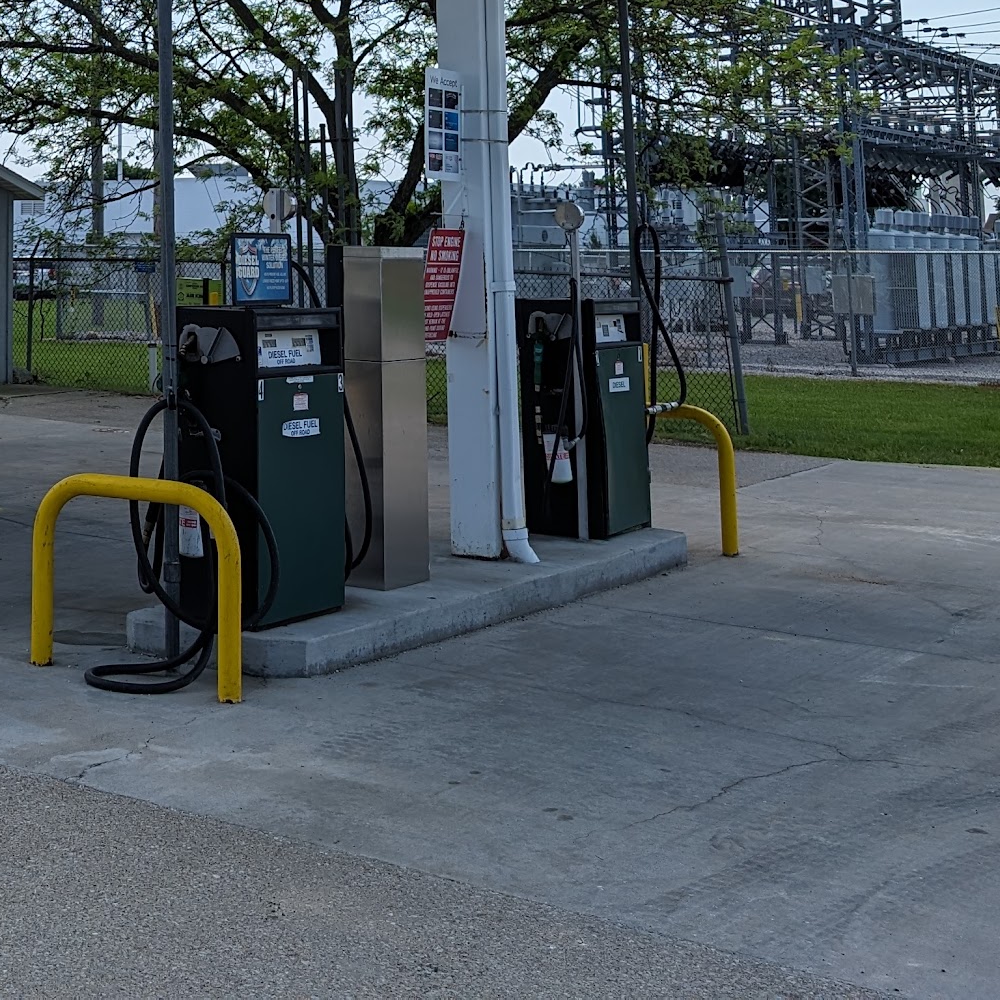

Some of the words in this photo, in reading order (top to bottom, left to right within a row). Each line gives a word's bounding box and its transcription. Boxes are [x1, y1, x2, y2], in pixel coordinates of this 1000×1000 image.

[430, 75, 439, 85] We
[440, 77, 458, 88] Accept
[431, 236, 444, 247] STOP
[444, 236, 461, 248] ENGINE
[236, 255, 259, 266] DIESEL
[430, 250, 438, 261] NO
[438, 250, 459, 261] SMOKING
[237, 266, 260, 279] GUARD
[268, 350, 288, 359] DIESEL
[288, 349, 302, 357] FUEL
[284, 421, 302, 430] DIESEL
[303, 420, 318, 429] FUEL
